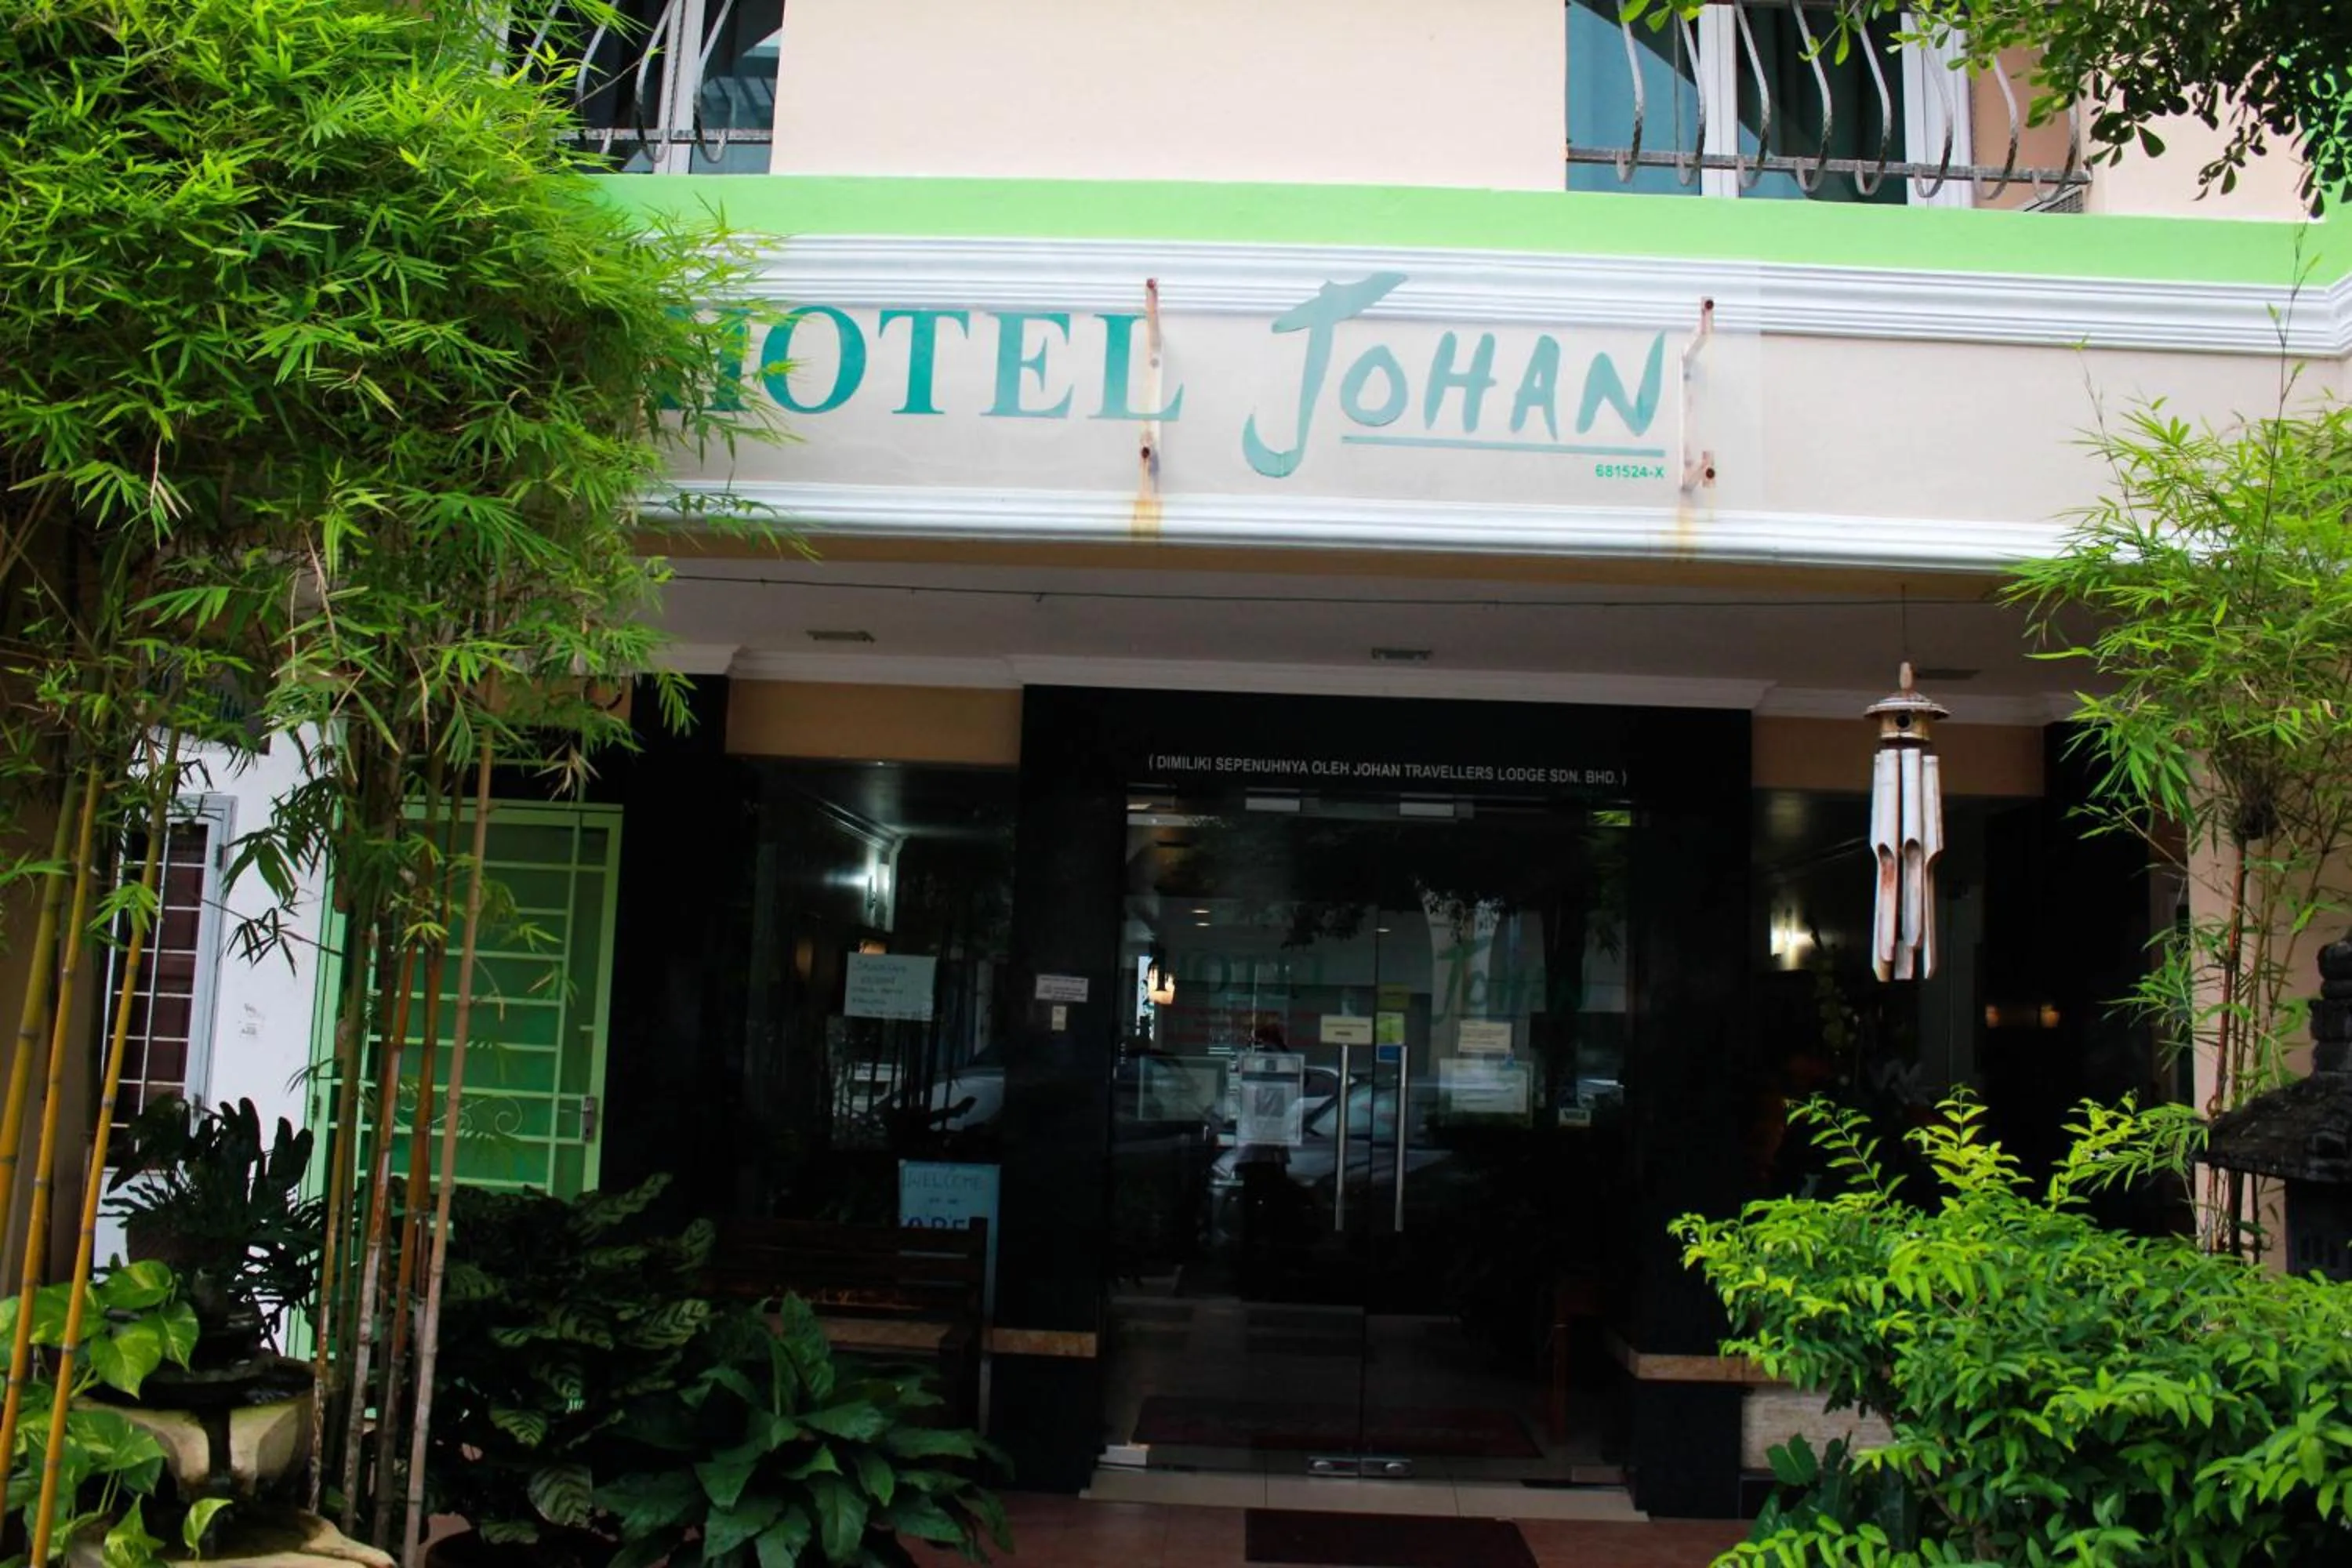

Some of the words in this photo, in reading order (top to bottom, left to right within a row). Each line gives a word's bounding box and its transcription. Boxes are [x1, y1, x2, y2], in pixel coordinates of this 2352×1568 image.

[1595, 463, 1664, 479] 681524-X
[1157, 754, 1211, 771] DIMILIKI
[1215, 757, 1308, 775] SEPENUHNYA
[1312, 760, 1349, 775] OLEH
[1352, 761, 1401, 778] JOHAN
[1404, 764, 1494, 781] TRAVELLERS
[1497, 766, 1547, 782] LODGE
[1549, 768, 1581, 784] SDN.
[1584, 770, 1619, 786] BHD.
